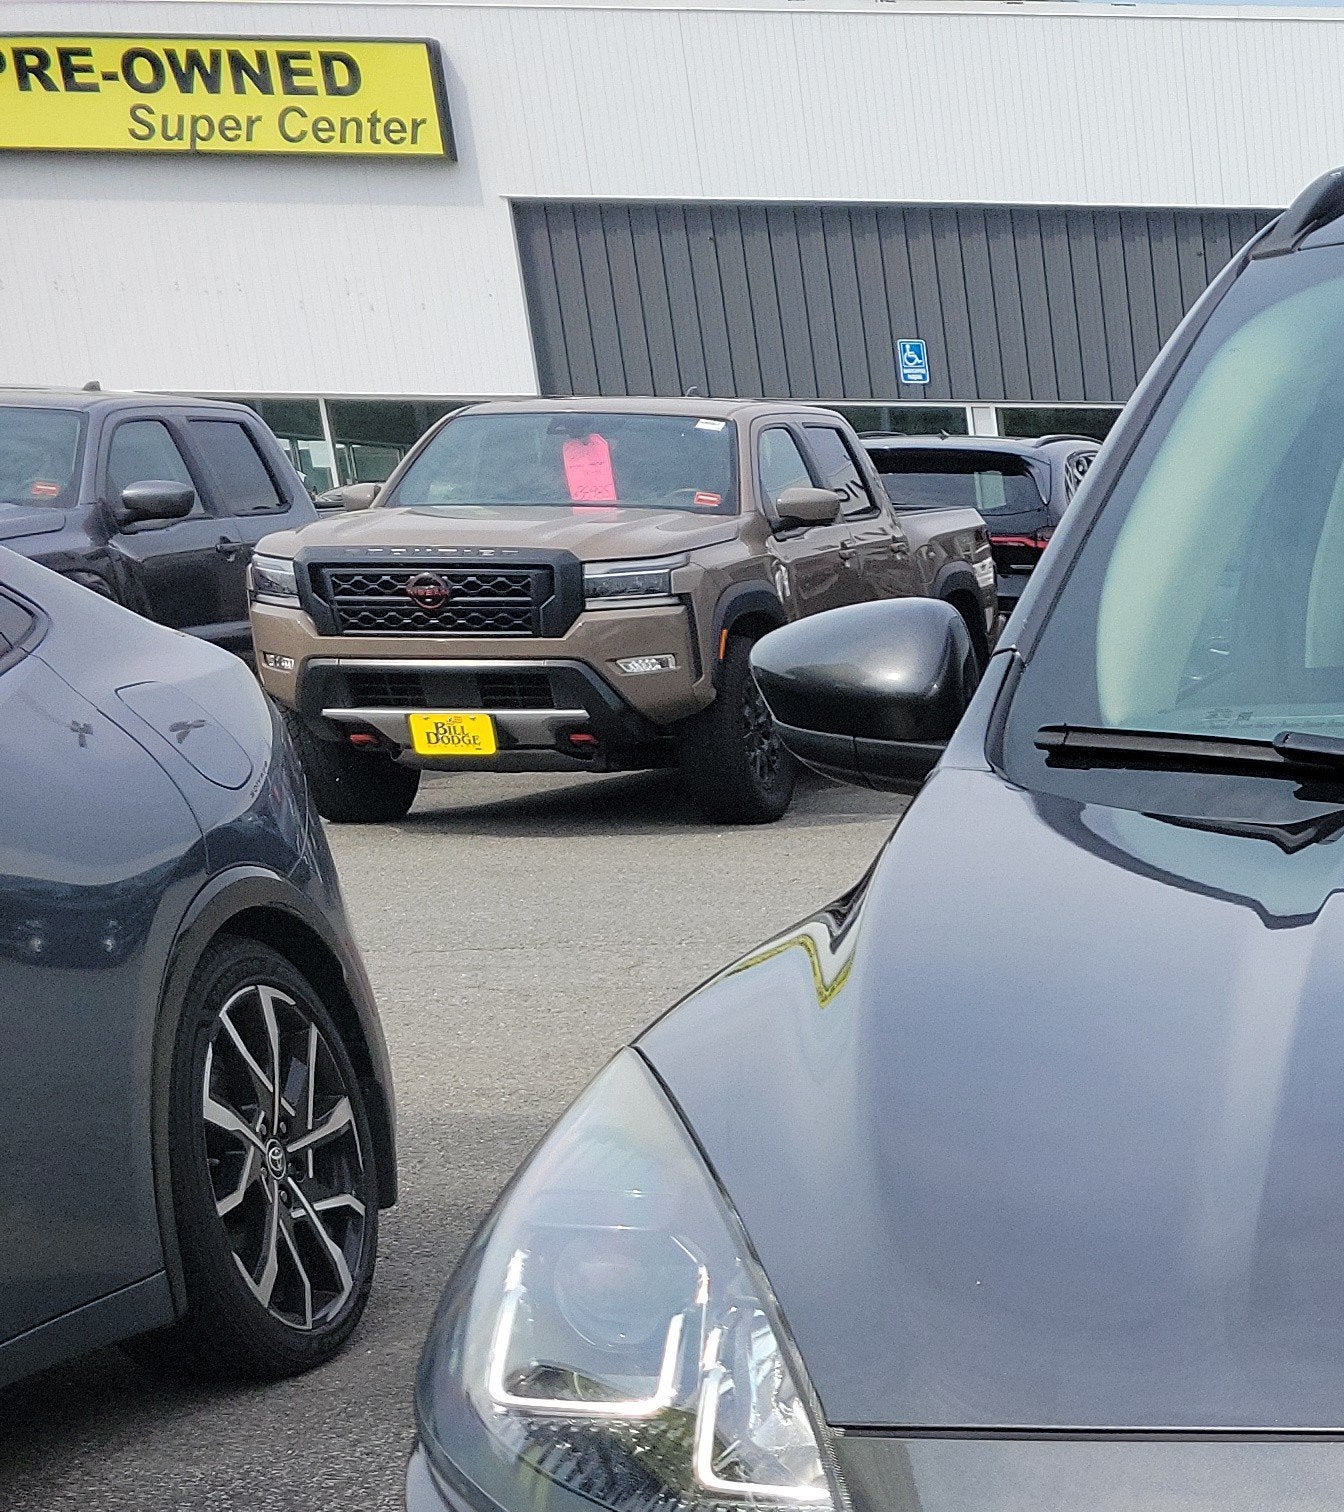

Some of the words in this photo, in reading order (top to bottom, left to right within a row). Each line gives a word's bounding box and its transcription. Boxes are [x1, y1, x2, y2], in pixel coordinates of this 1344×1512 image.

[127, 103, 262, 151] Super
[277, 105, 427, 145] Center
[433, 721, 470, 736] BILL
[425, 731, 481, 746] DODGE
